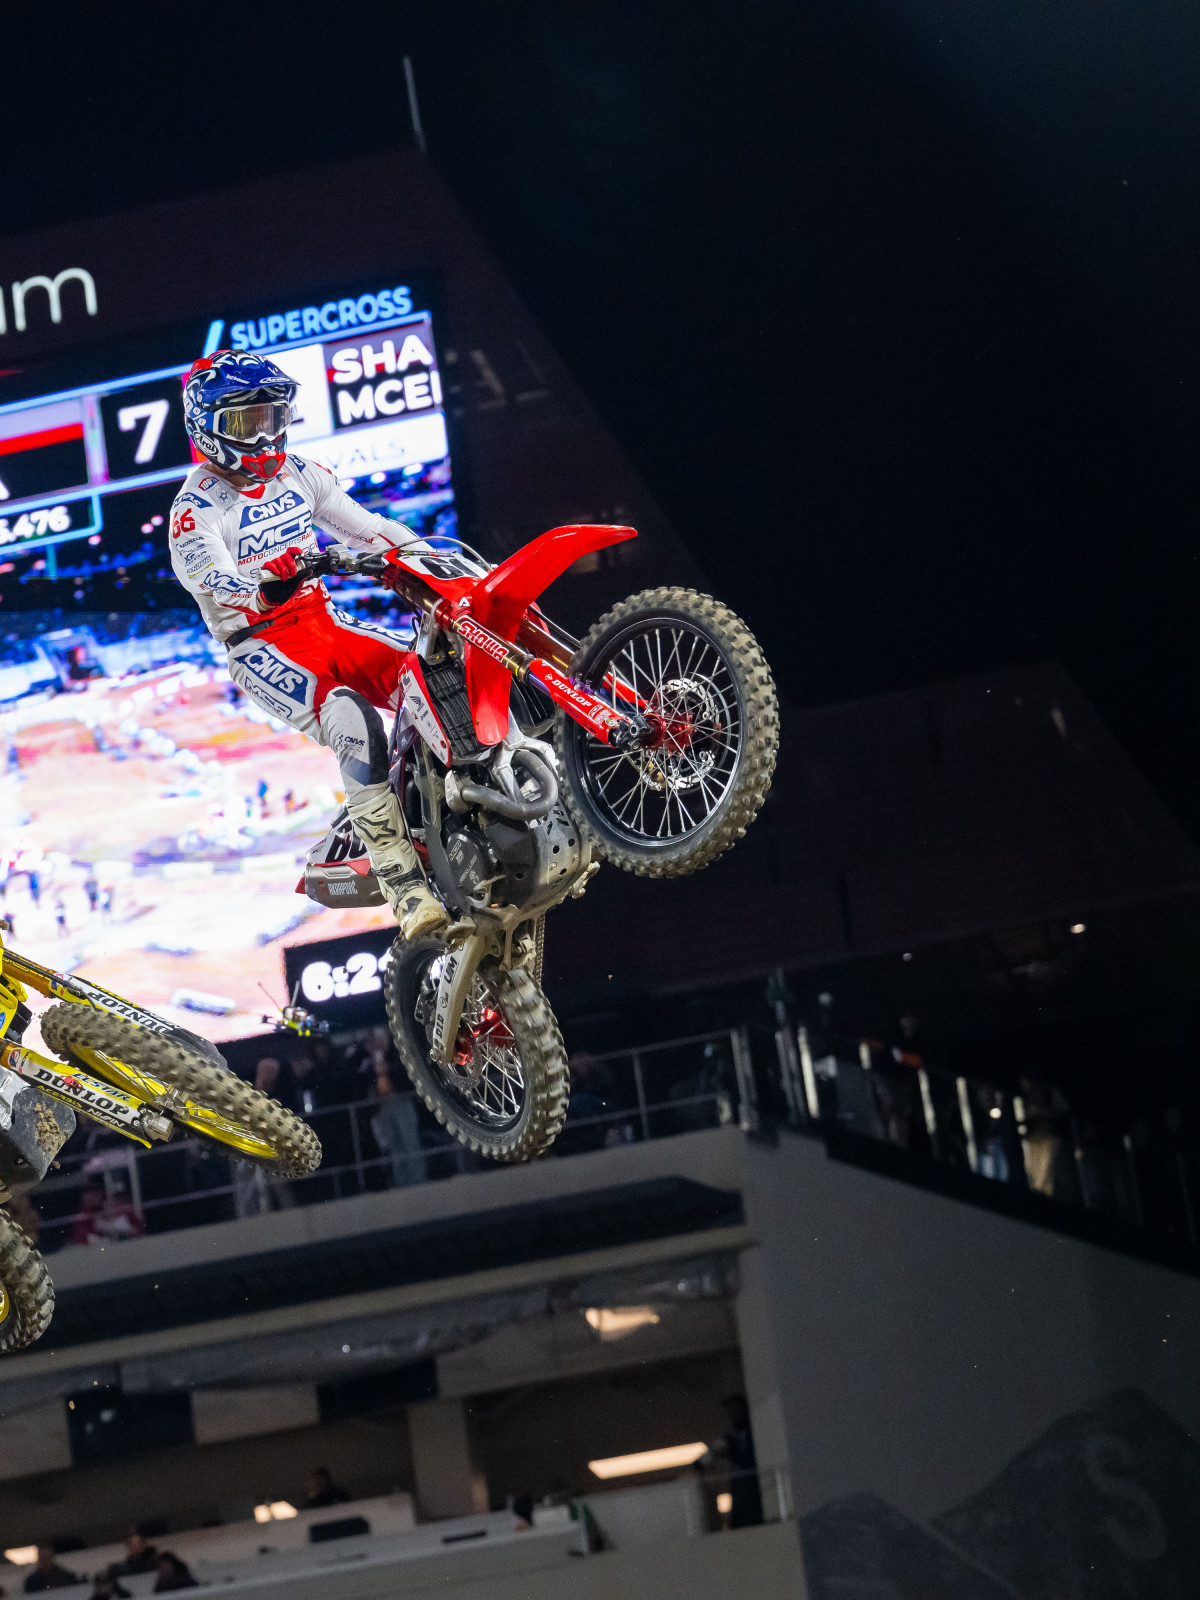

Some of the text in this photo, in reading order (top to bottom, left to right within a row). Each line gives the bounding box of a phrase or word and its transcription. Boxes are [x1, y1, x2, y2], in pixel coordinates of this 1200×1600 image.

[231, 286, 413, 351] SUPERCROSS
[331, 334, 433, 384] SHA
[117, 400, 170, 464] 7
[199, 434, 216, 452] Arai
[326, 438, 407, 470] VALS
[248, 491, 296, 523] CNVS
[172, 508, 196, 539] 66
[179, 536, 205, 548] HONDA
[456, 620, 510, 663] SHOWA
[245, 650, 303, 694] CNVS
[551, 678, 593, 708] DUNLOP
[344, 735, 366, 747] CNVS
[87, 991, 169, 1035] DUNLOP
[34, 1068, 130, 1115] DUNLOP
[72, 1072, 131, 1103] ECSTAR
